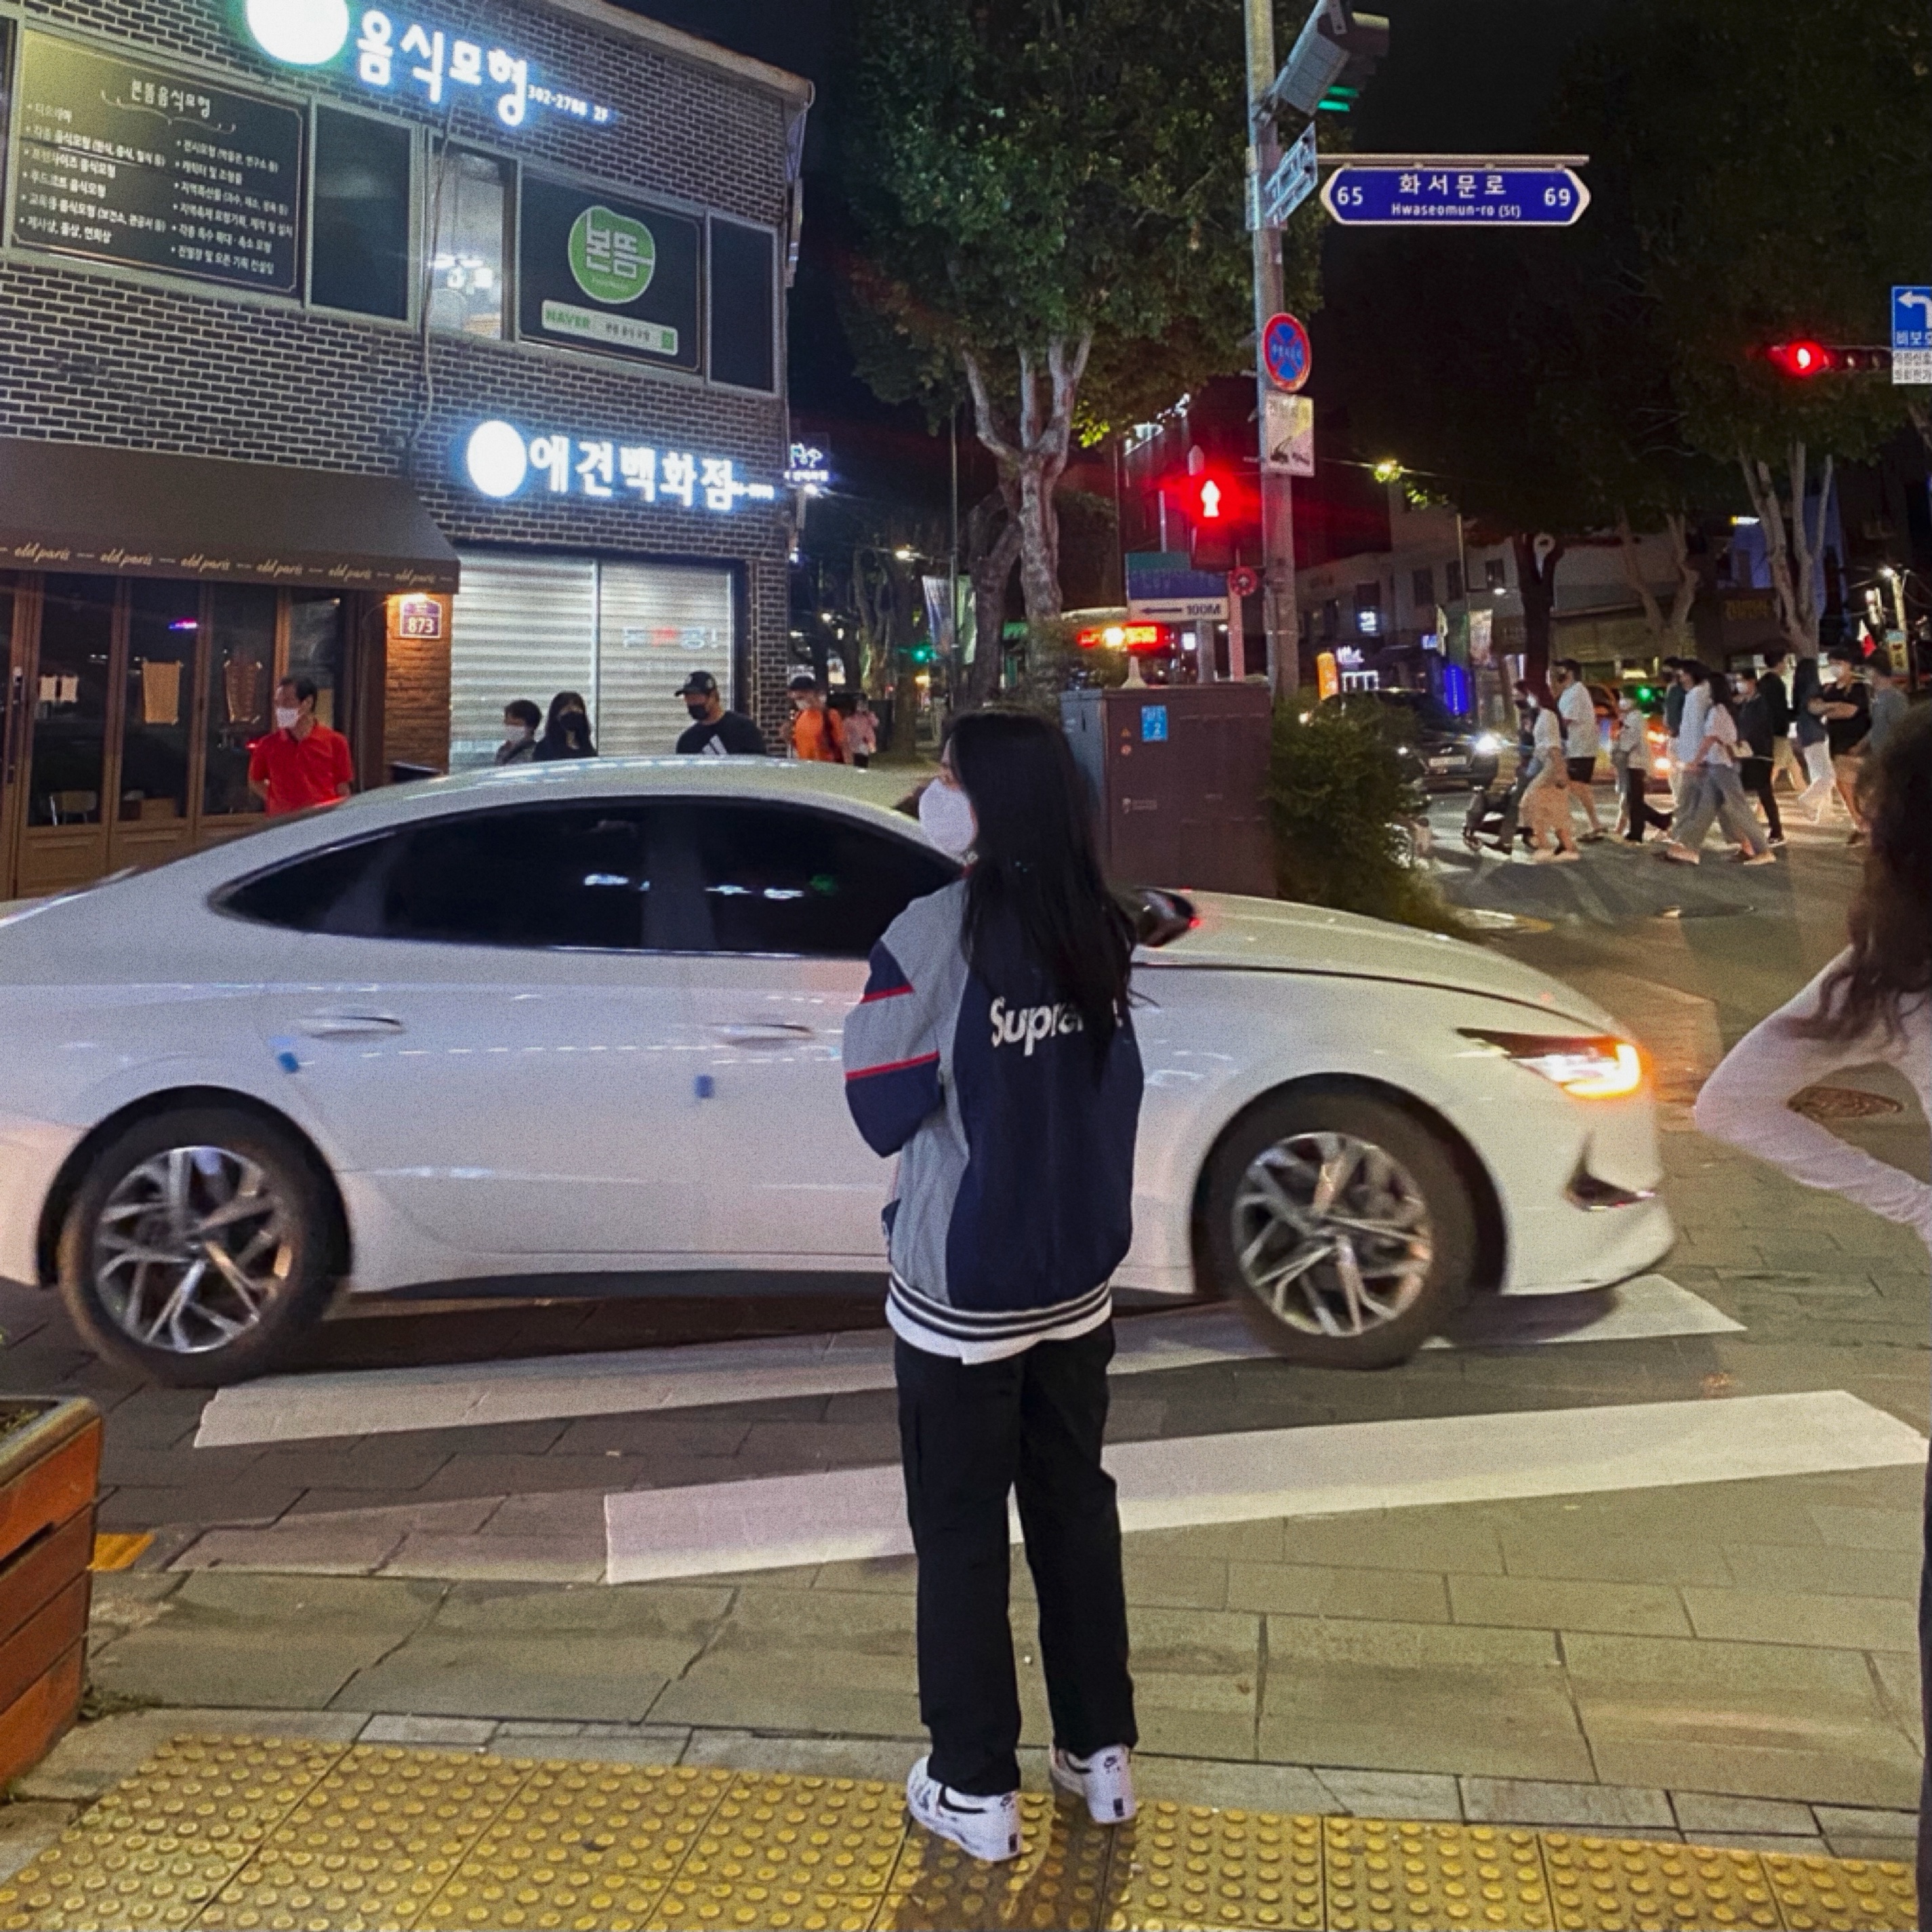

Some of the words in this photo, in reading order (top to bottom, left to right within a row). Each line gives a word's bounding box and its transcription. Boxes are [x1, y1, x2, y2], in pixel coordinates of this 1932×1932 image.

[356, 9, 527, 127] 음식모형
[1337, 186, 1363, 205] 65
[1399, 173, 1506, 199] 화서문로
[1544, 187, 1571, 207] 69
[1391, 203, 1495, 216] Hwaseomun-ro
[545, 309, 590, 329] NAVER
[529, 434, 733, 511] 애견백화점
[408, 617, 434, 634] 873
